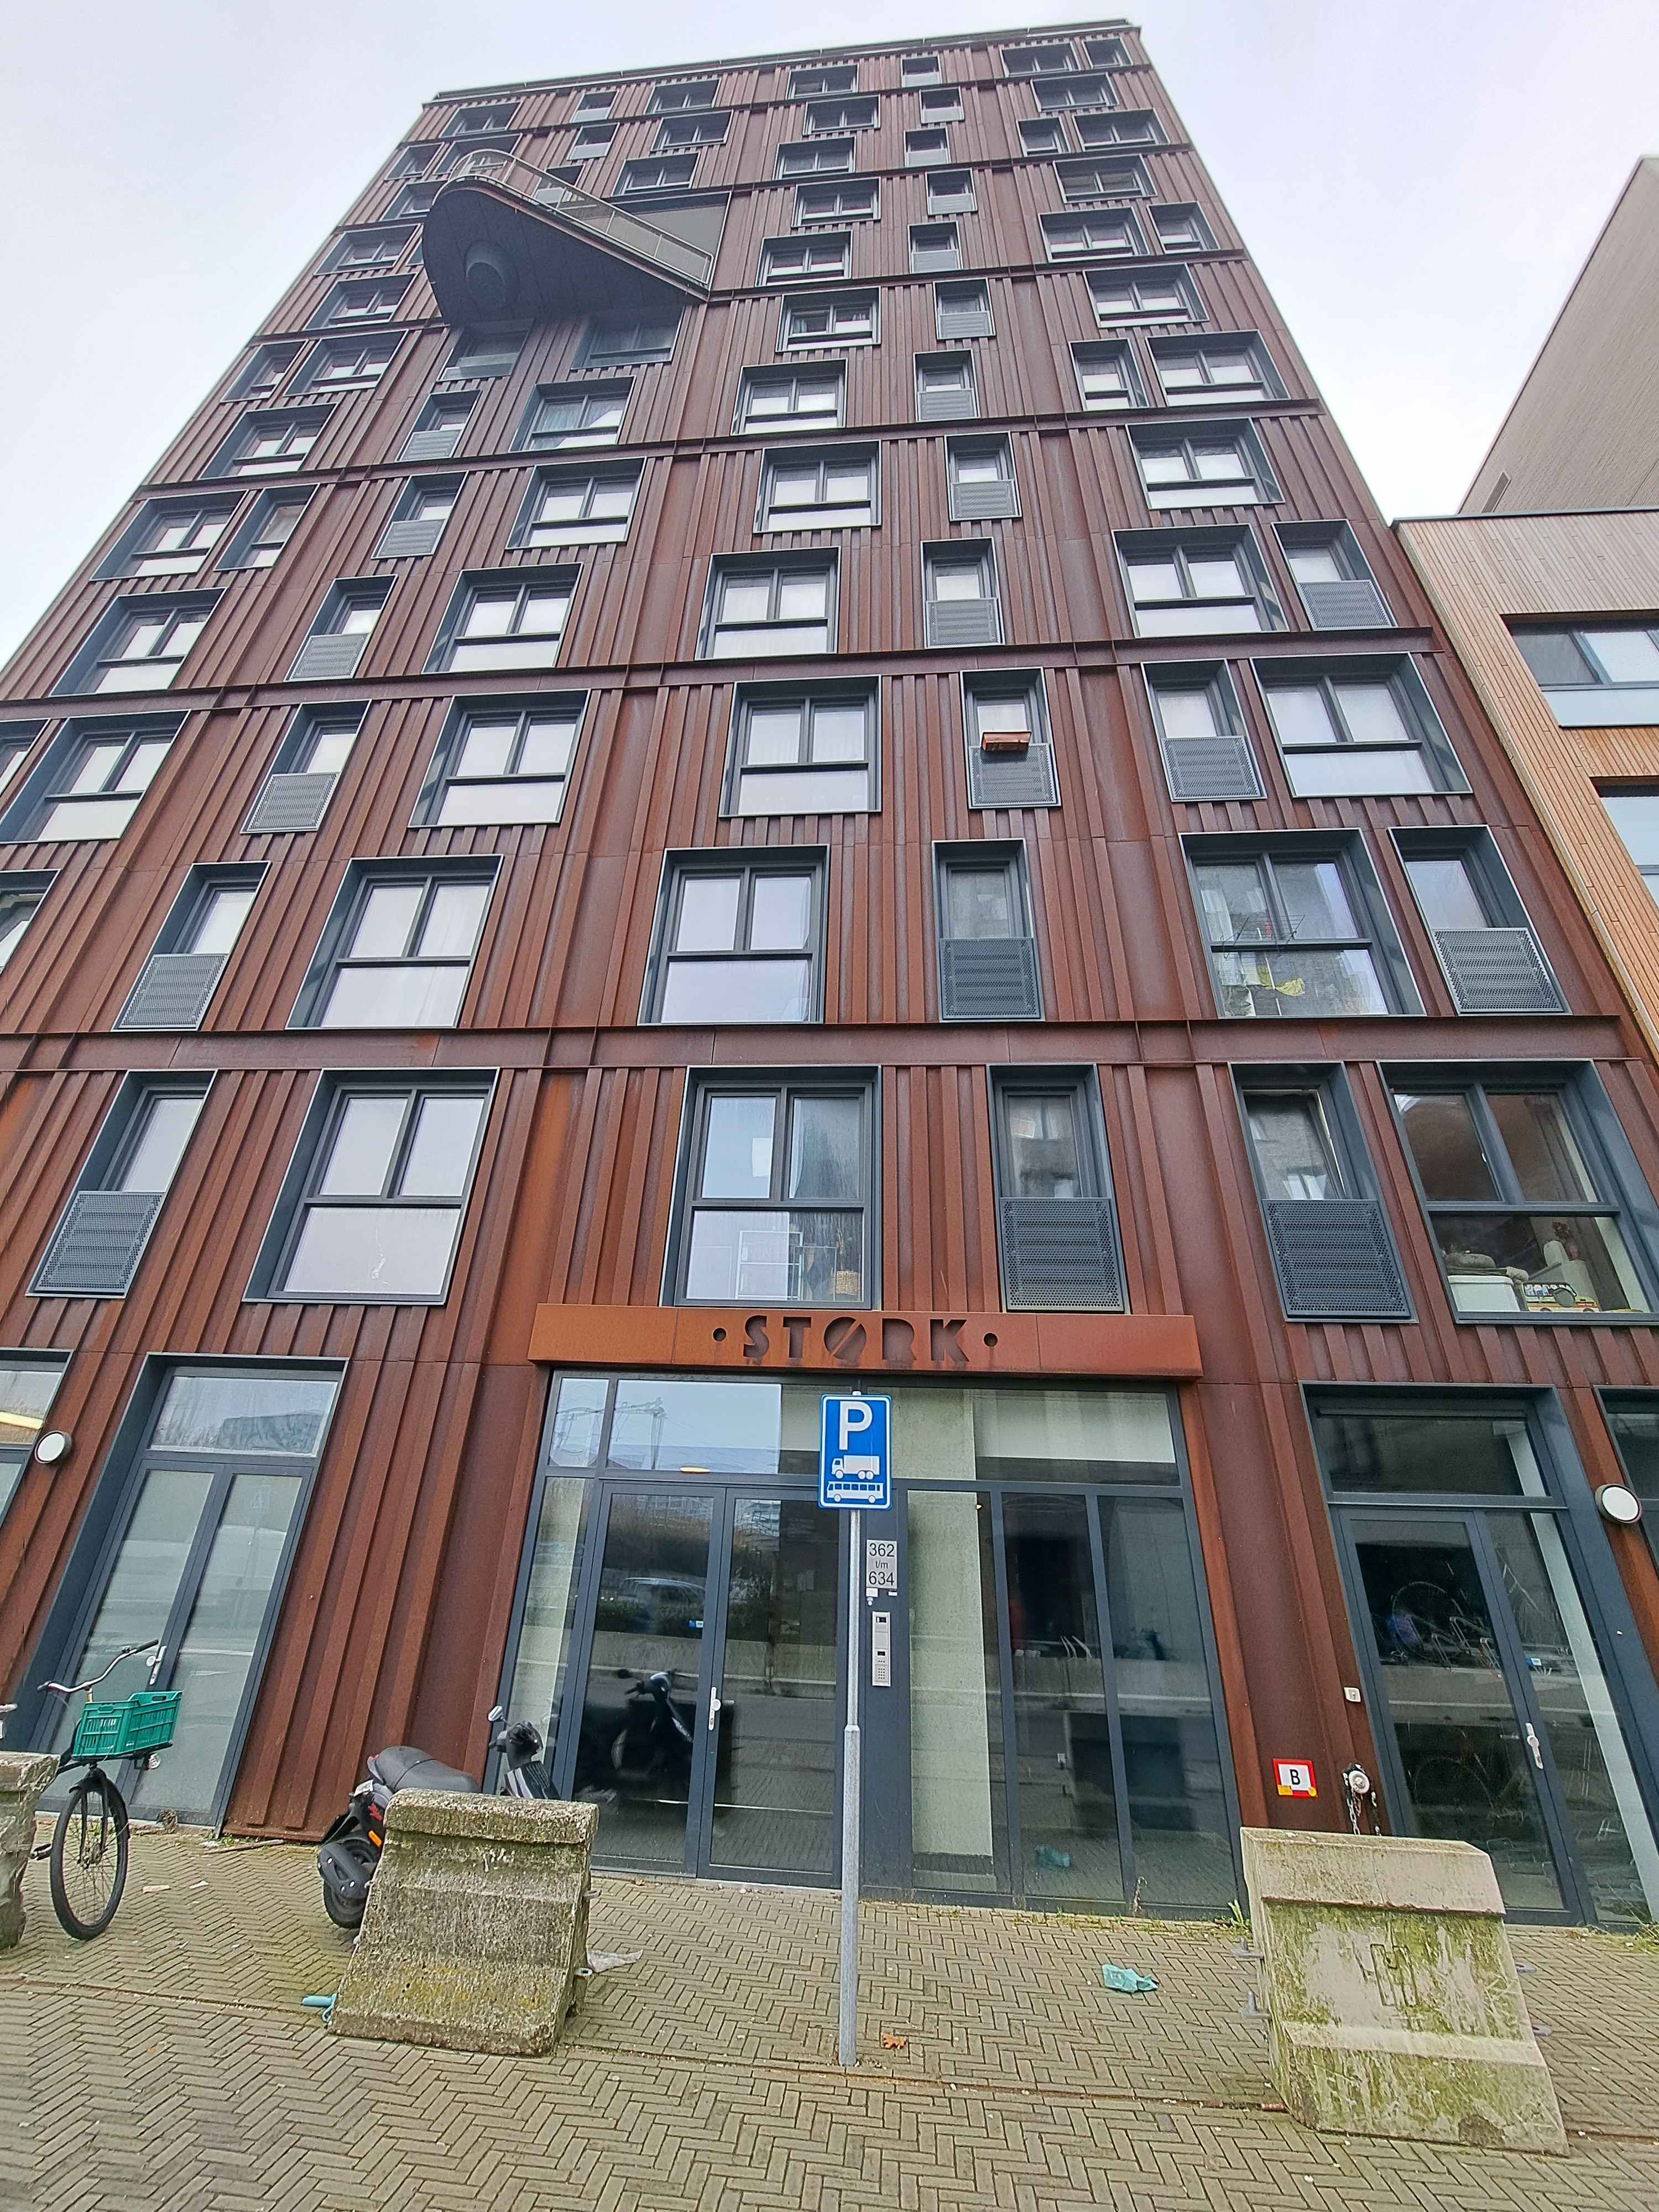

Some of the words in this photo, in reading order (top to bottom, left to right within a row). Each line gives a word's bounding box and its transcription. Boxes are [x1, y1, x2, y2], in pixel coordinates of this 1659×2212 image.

[839, 1401, 872, 1450] P
[869, 1543, 894, 1557] 362
[875, 1560, 888, 1569] t/m
[869, 1571, 895, 1585] 634
[1290, 1768, 1301, 1785] B
